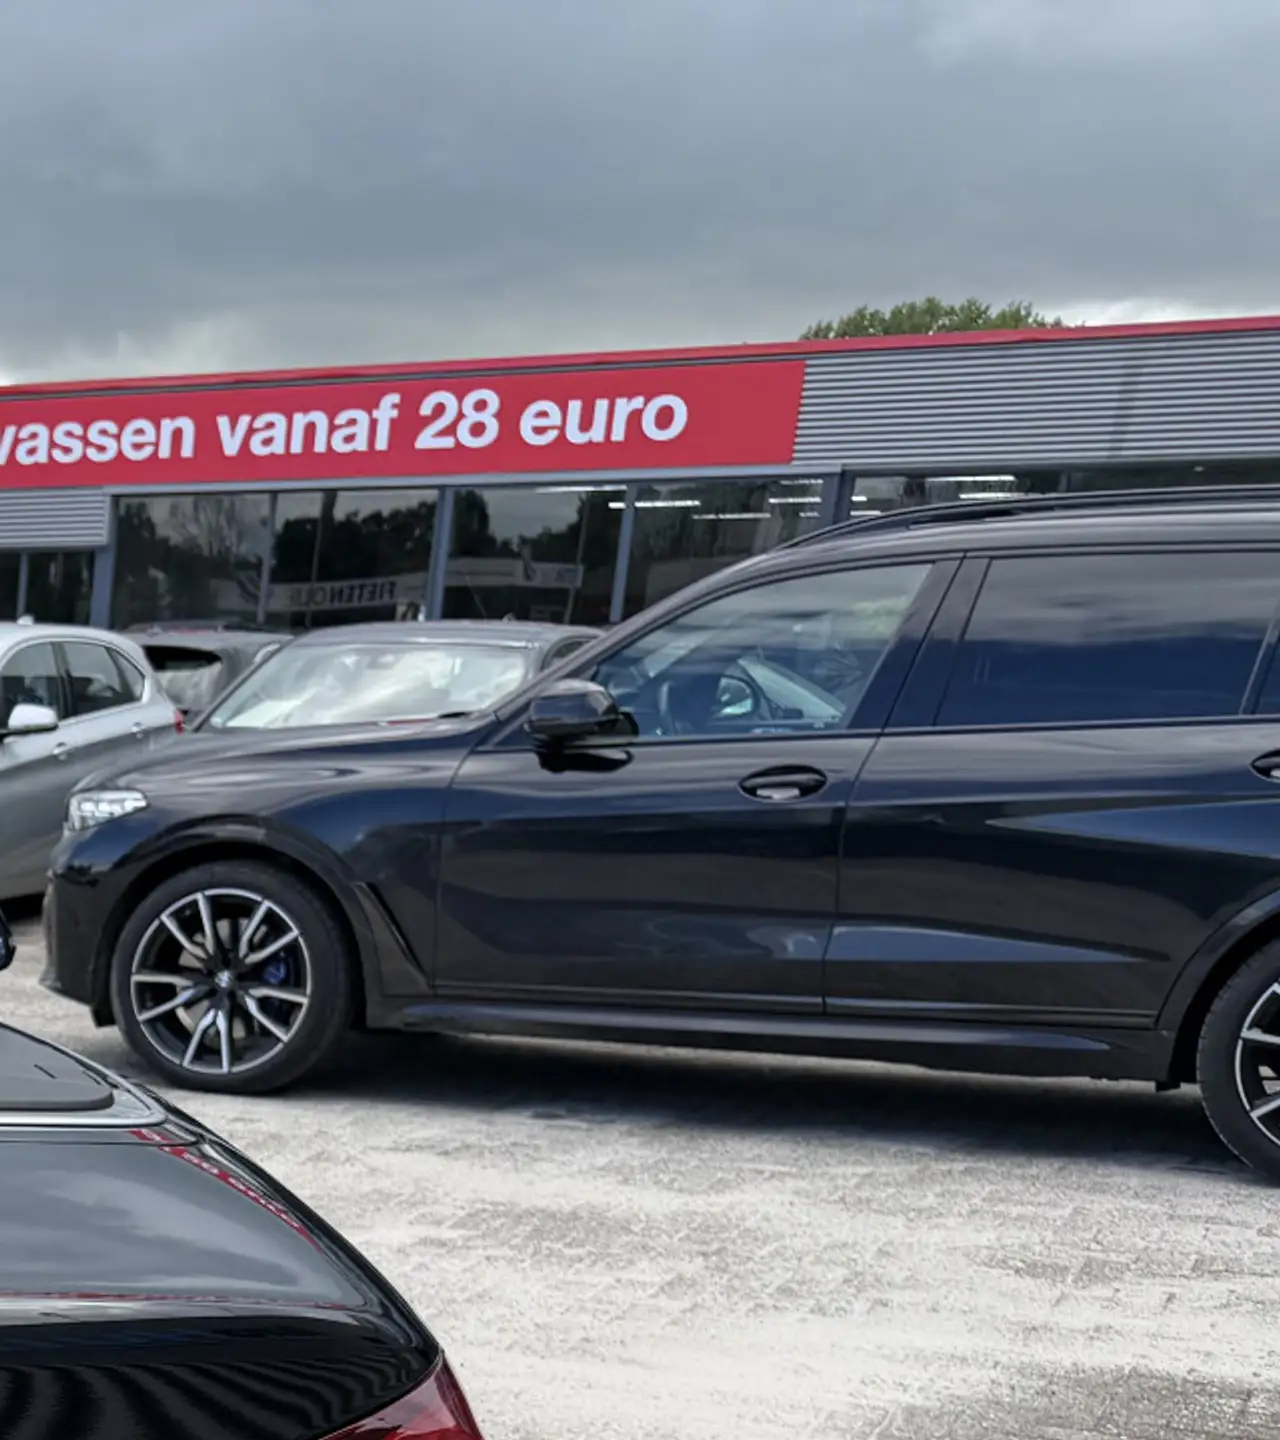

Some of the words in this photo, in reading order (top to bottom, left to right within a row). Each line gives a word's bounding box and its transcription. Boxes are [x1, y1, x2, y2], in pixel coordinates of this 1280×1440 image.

[215, 393, 400, 457] vanaf
[414, 388, 500, 450] 28
[519, 394, 688, 446] euro
